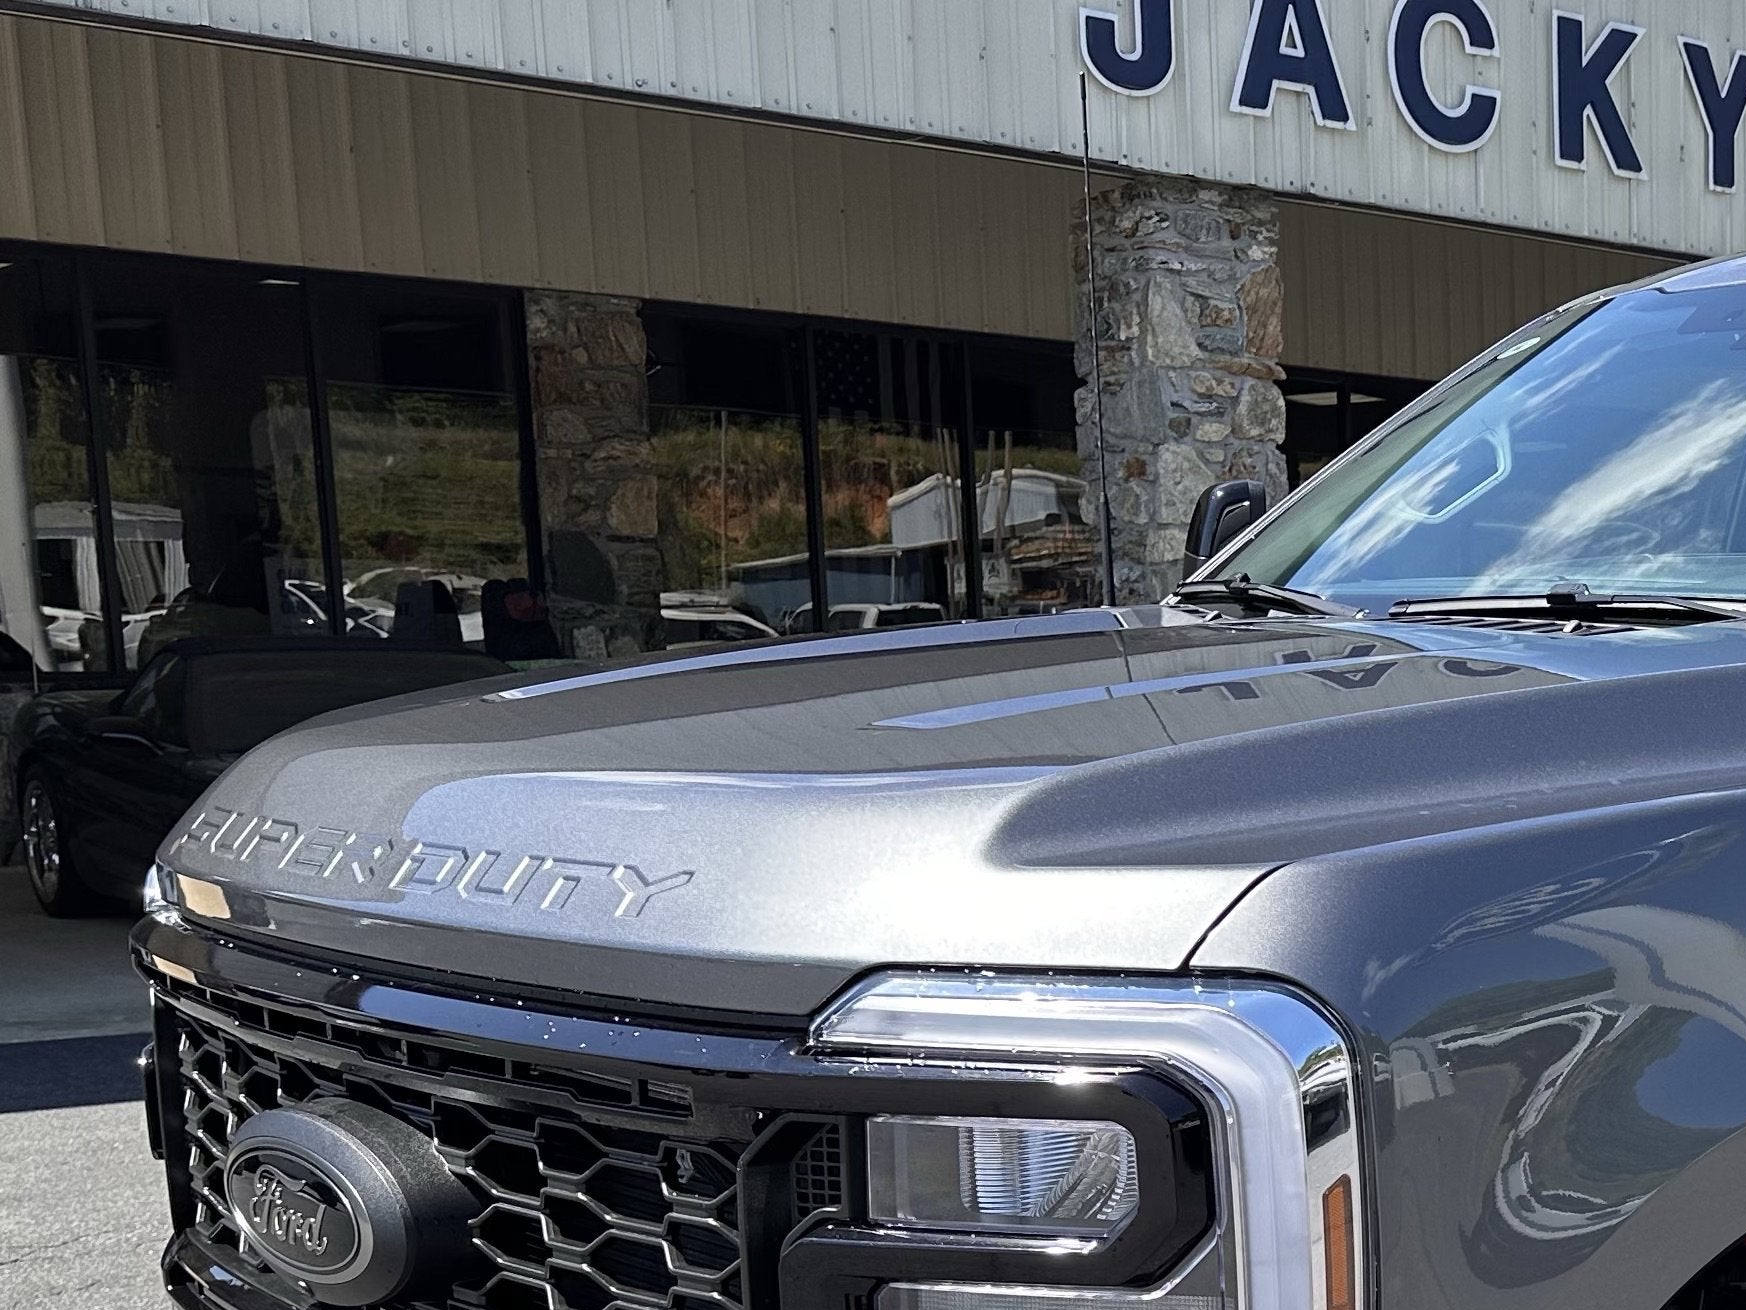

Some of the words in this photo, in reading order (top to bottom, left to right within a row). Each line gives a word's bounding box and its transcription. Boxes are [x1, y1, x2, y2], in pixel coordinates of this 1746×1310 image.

[170, 806, 394, 885] SUPER
[388, 842, 695, 919] DUTY
[249, 1164, 328, 1255] Ford
